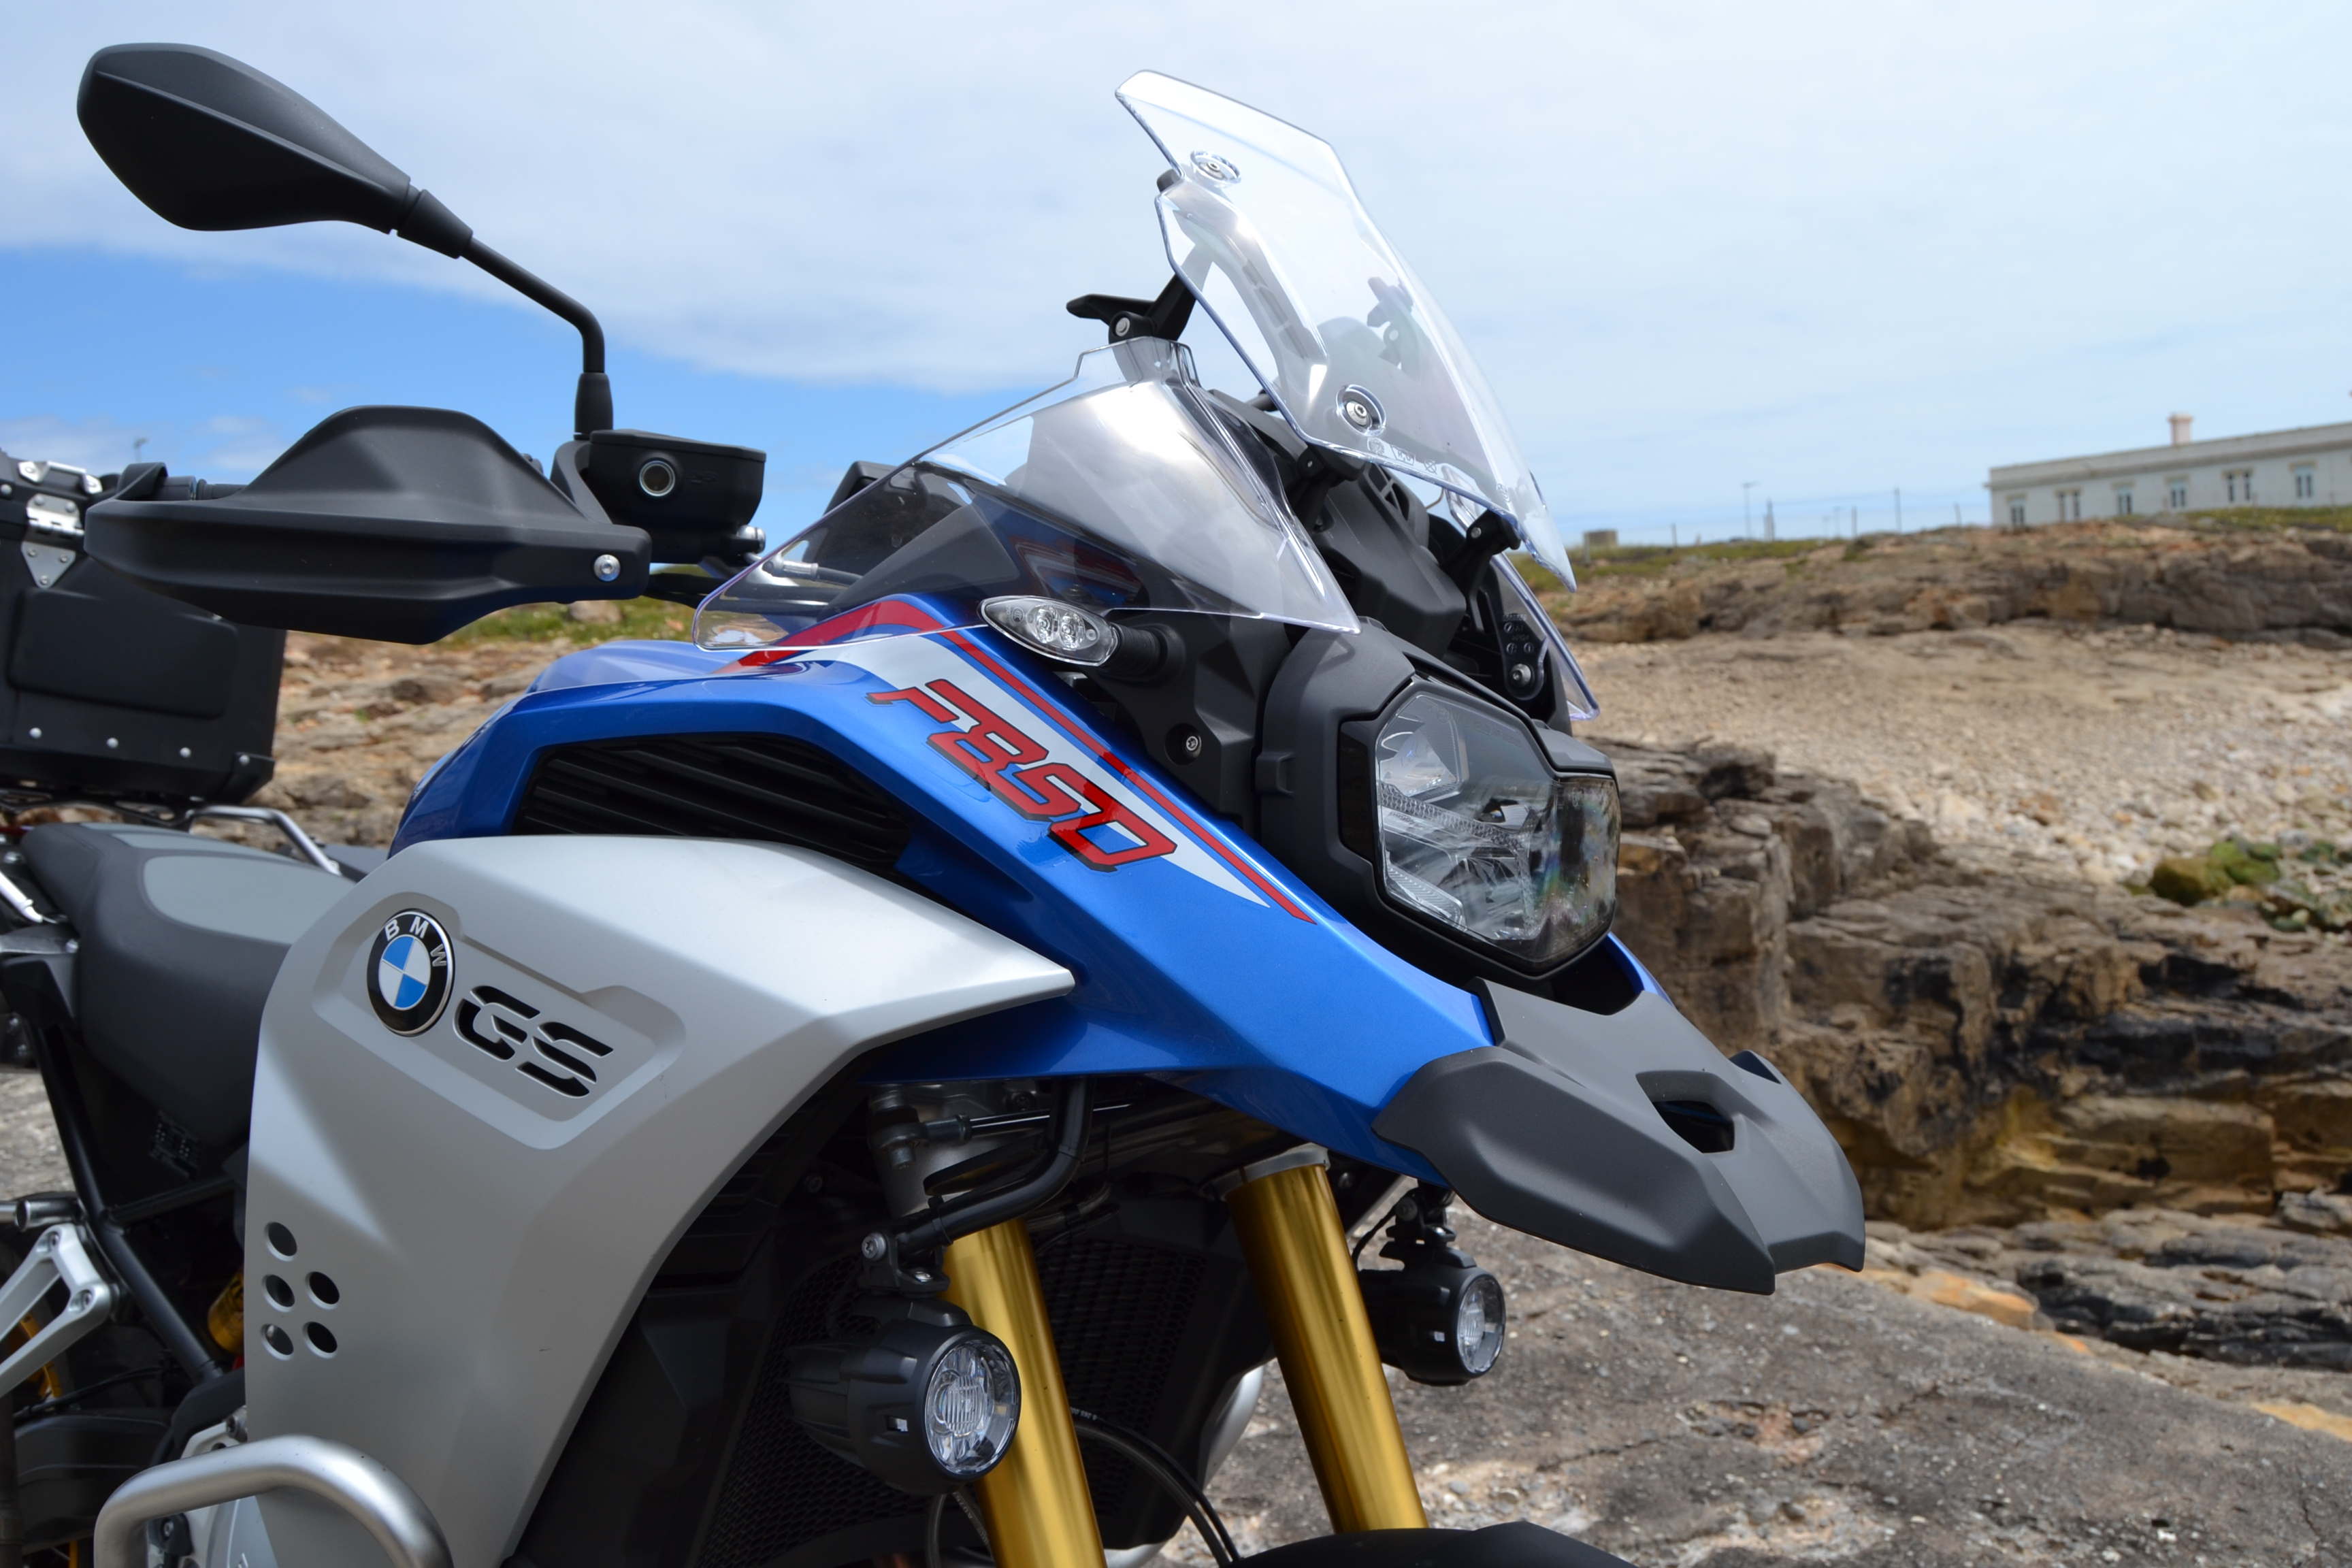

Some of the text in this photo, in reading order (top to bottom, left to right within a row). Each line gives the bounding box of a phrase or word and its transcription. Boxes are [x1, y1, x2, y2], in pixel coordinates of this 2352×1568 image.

[864, 679, 1178, 872] F850
[385, 916, 447, 967] BMW
[453, 985, 614, 1098] GS
